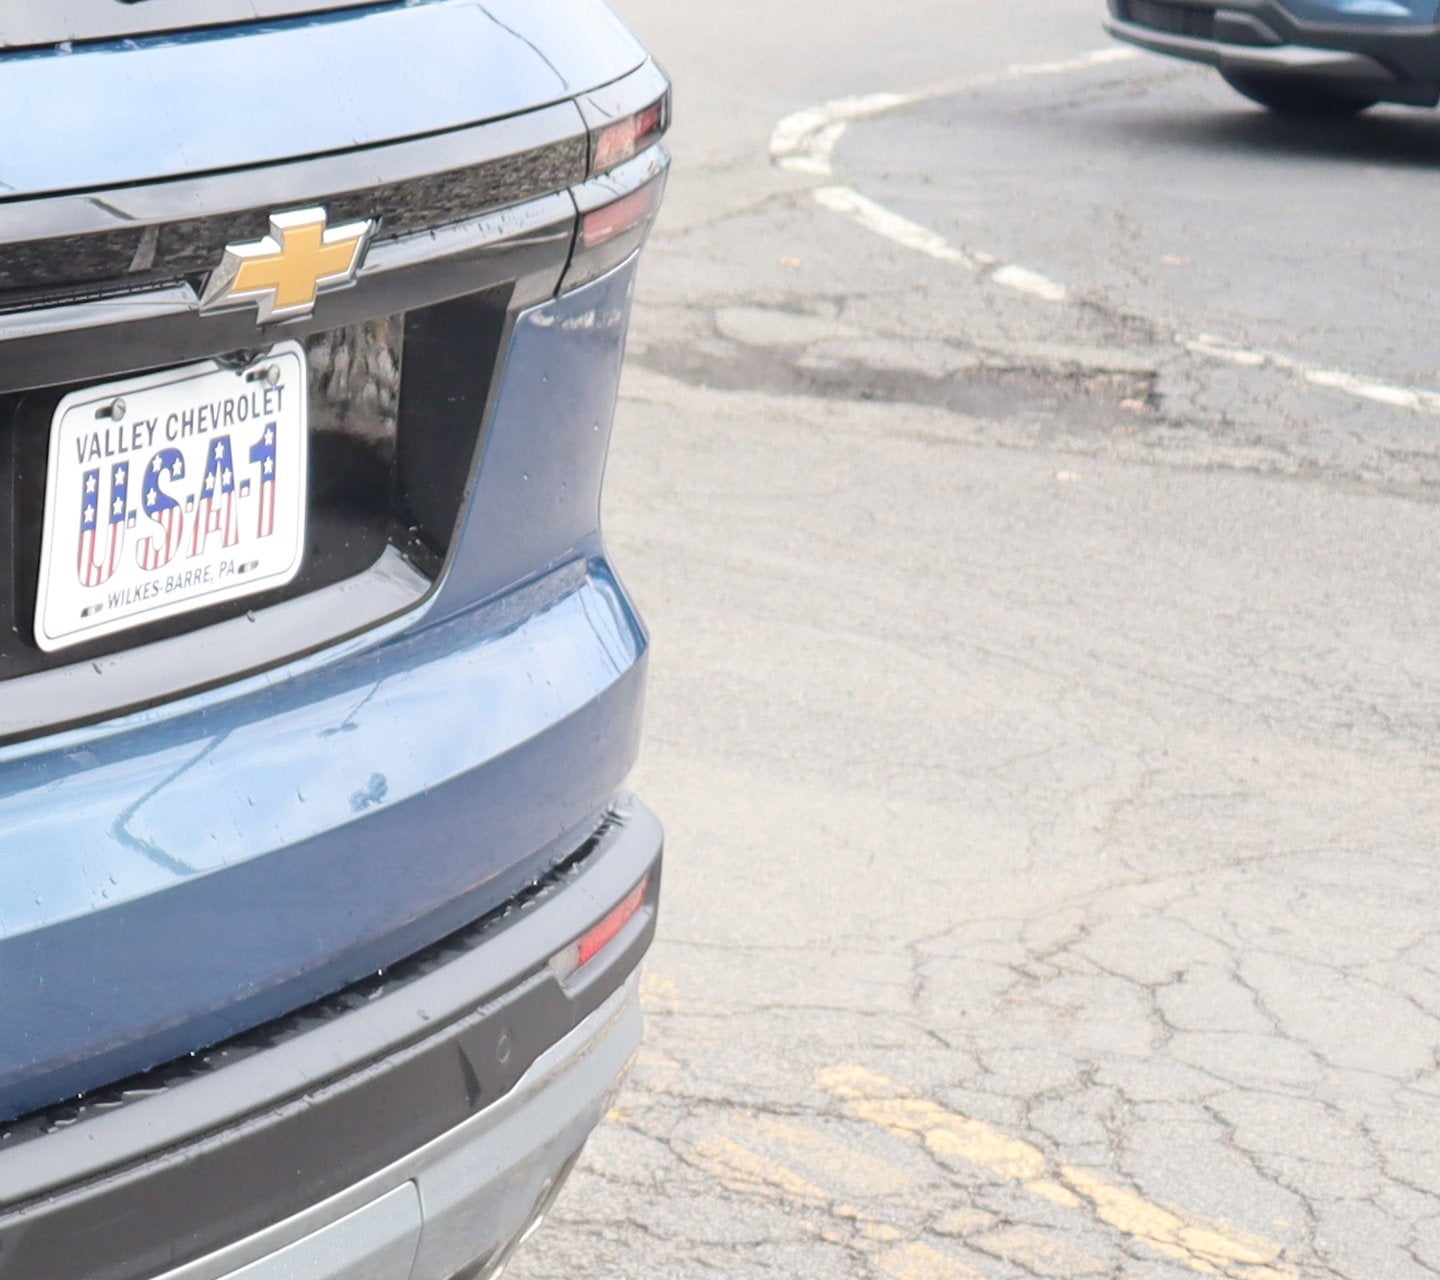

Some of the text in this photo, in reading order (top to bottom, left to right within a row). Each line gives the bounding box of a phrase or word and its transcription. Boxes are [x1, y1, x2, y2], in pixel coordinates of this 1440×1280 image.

[76, 384, 285, 464] VALLEY CHEVROLET
[108, 559, 238, 609] WILKES-BARRE, PA
